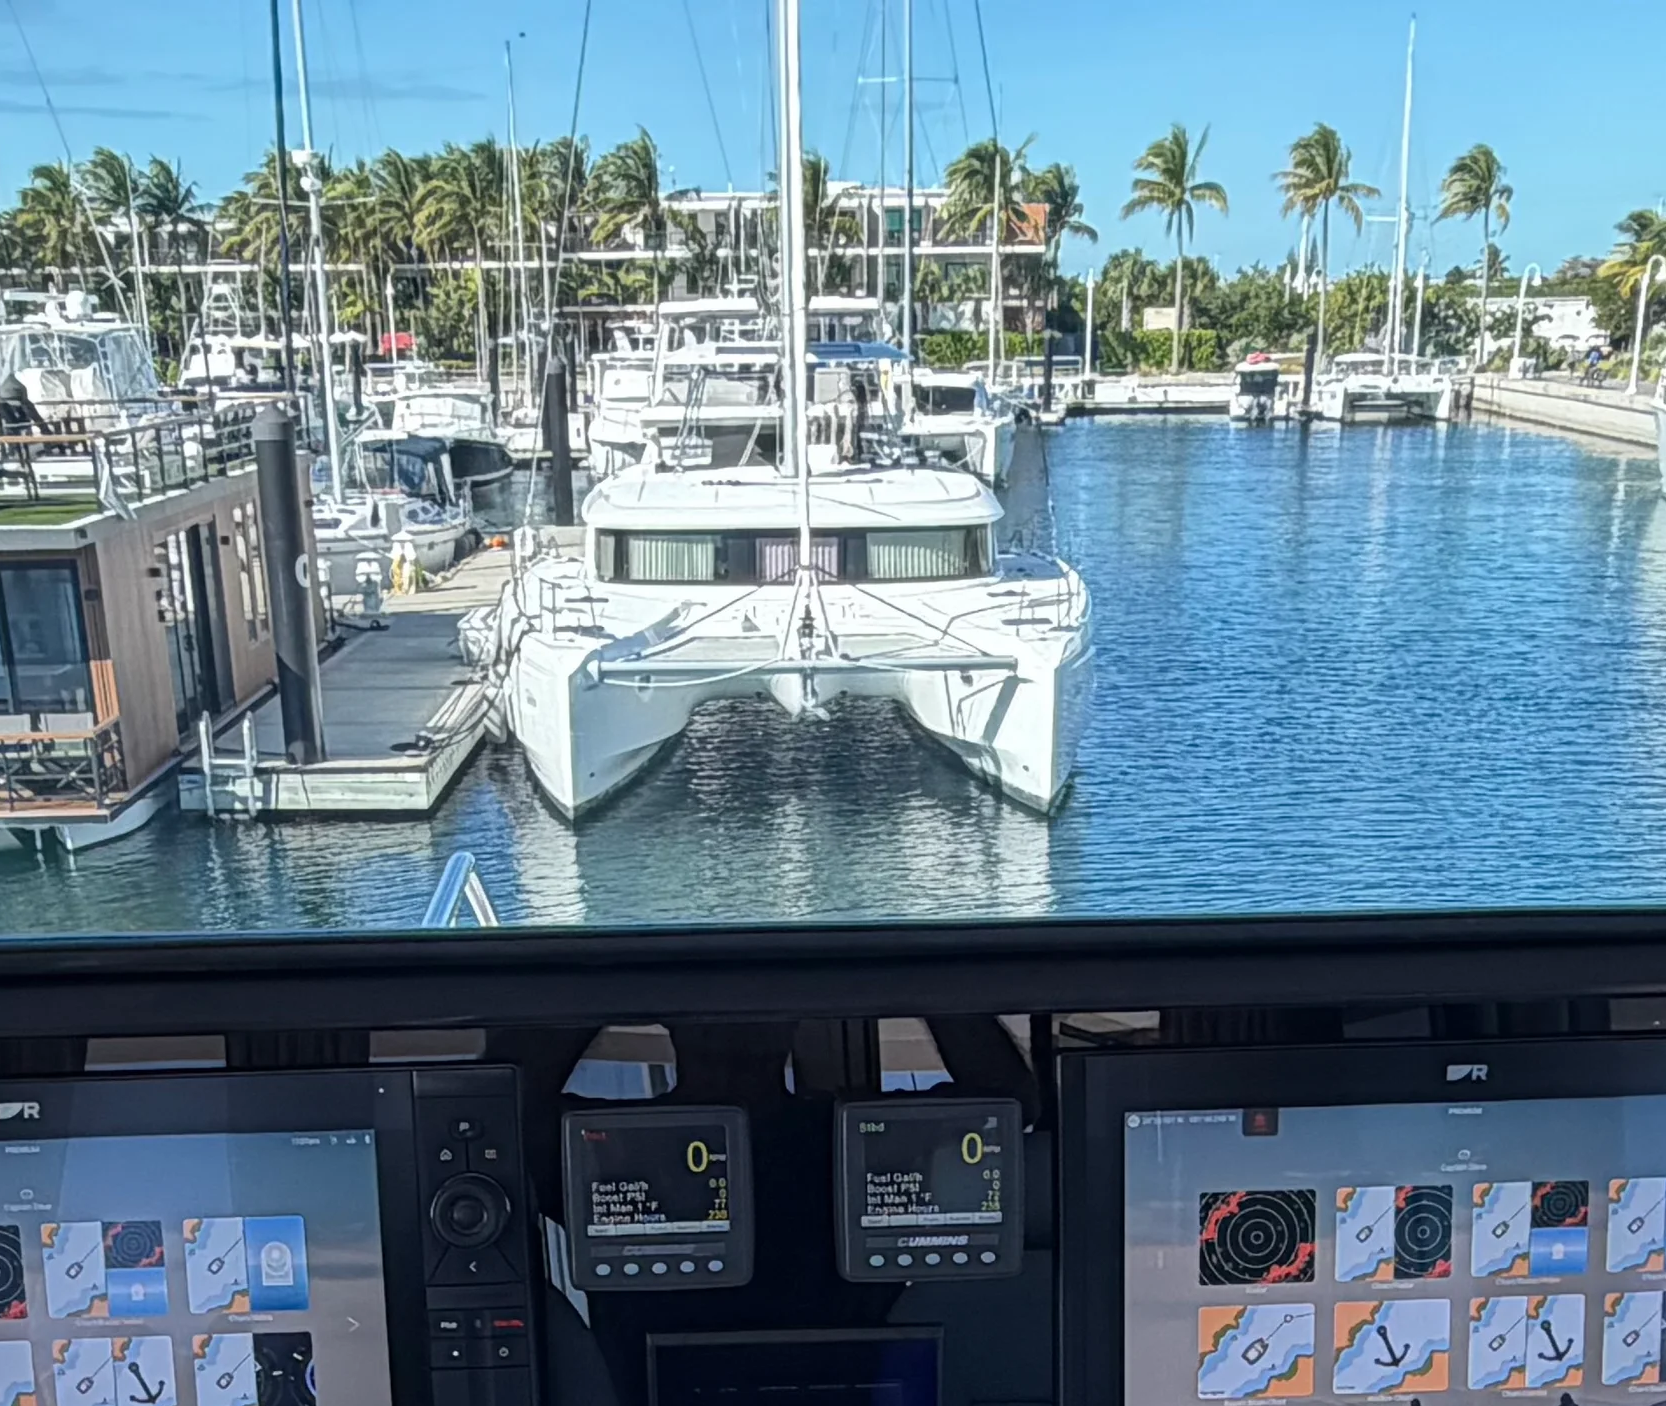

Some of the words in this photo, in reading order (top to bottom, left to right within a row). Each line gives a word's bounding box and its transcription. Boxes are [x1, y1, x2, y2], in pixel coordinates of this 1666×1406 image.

[961, 1132, 983, 1164] 0
[687, 1141, 708, 1173] 0
[867, 1173, 890, 1183] Fuel
[591, 1181, 616, 1192] Fuel
[867, 1184, 898, 1193] Boost
[897, 1235, 969, 1247] CUMMINS
